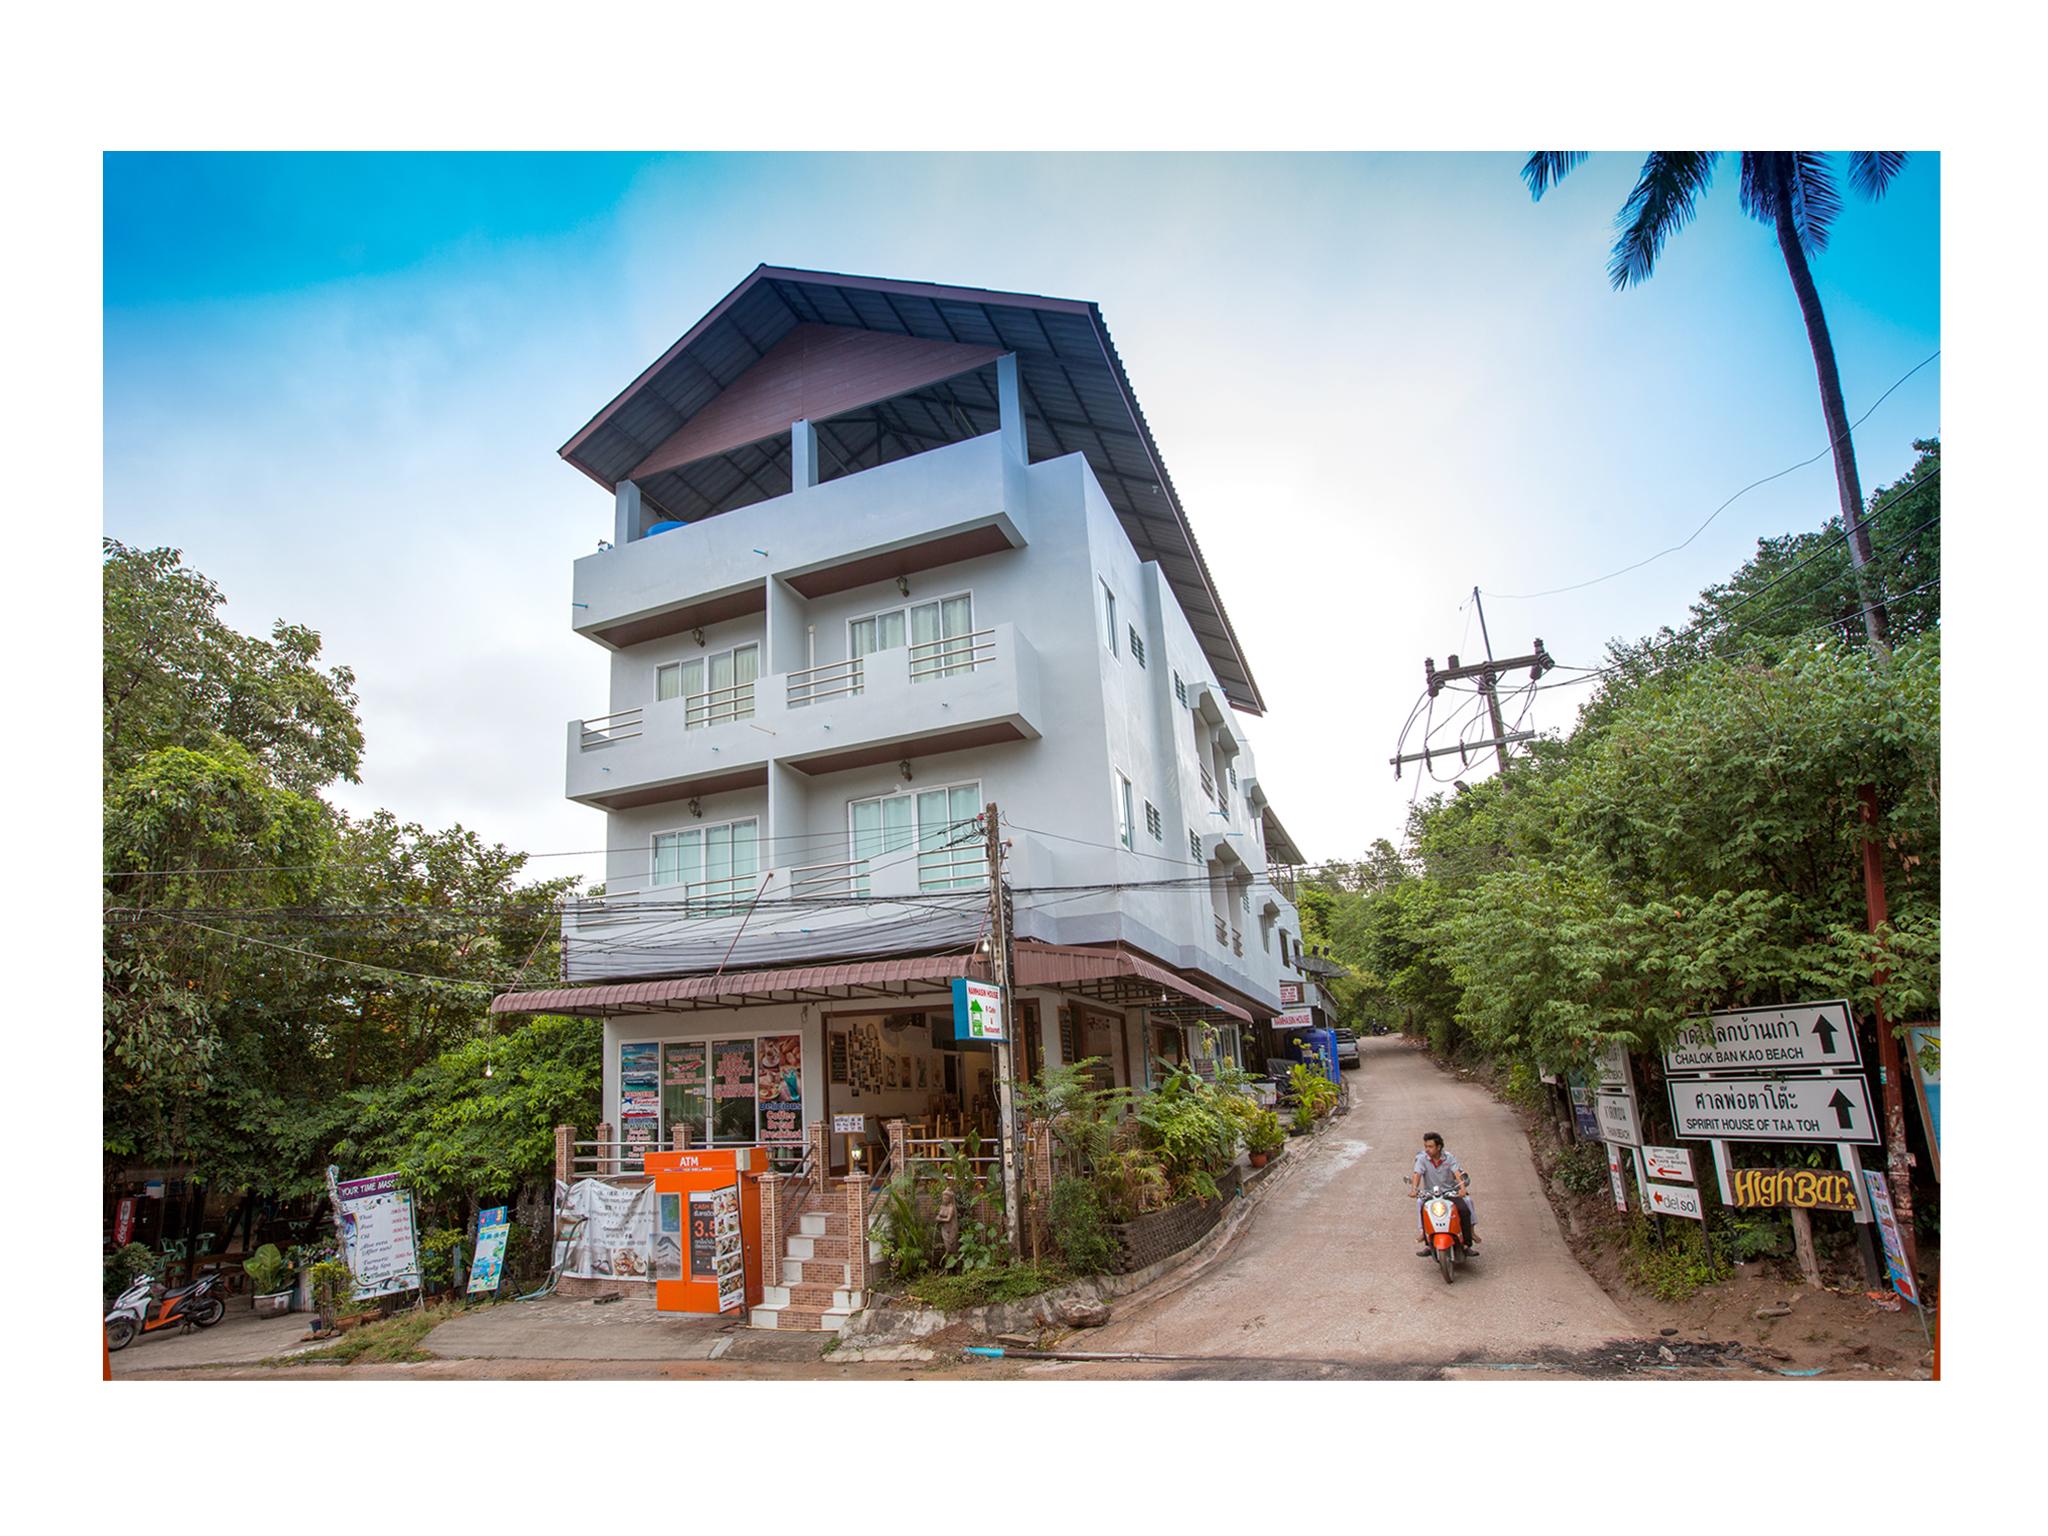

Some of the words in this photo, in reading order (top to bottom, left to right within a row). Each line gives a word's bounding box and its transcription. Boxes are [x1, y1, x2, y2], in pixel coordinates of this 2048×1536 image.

[987, 991, 999, 999] HOUSE
[1675, 1050, 1714, 1065] CHALOK
[1716, 1050, 1739, 1063] BAN
[1740, 1049, 1764, 1062] KAO
[1766, 1047, 1805, 1061] BEACH
[1695, 1084, 1799, 1111] ศาลพ่อตาโต๊ะ
[767, 1110, 796, 1120] Coffee
[1686, 1118, 1719, 1130] SPRIRIT
[1722, 1118, 1755, 1131] HOUSE
[1757, 1119, 1770, 1131] OF
[1773, 1119, 1795, 1132] TAA
[1797, 1120, 1820, 1132] TOH
[679, 1156, 699, 1167] ATM
[341, 1186, 359, 1197] YOUR
[361, 1182, 377, 1193] TIME
[1680, 1200, 1698, 1214] sol
